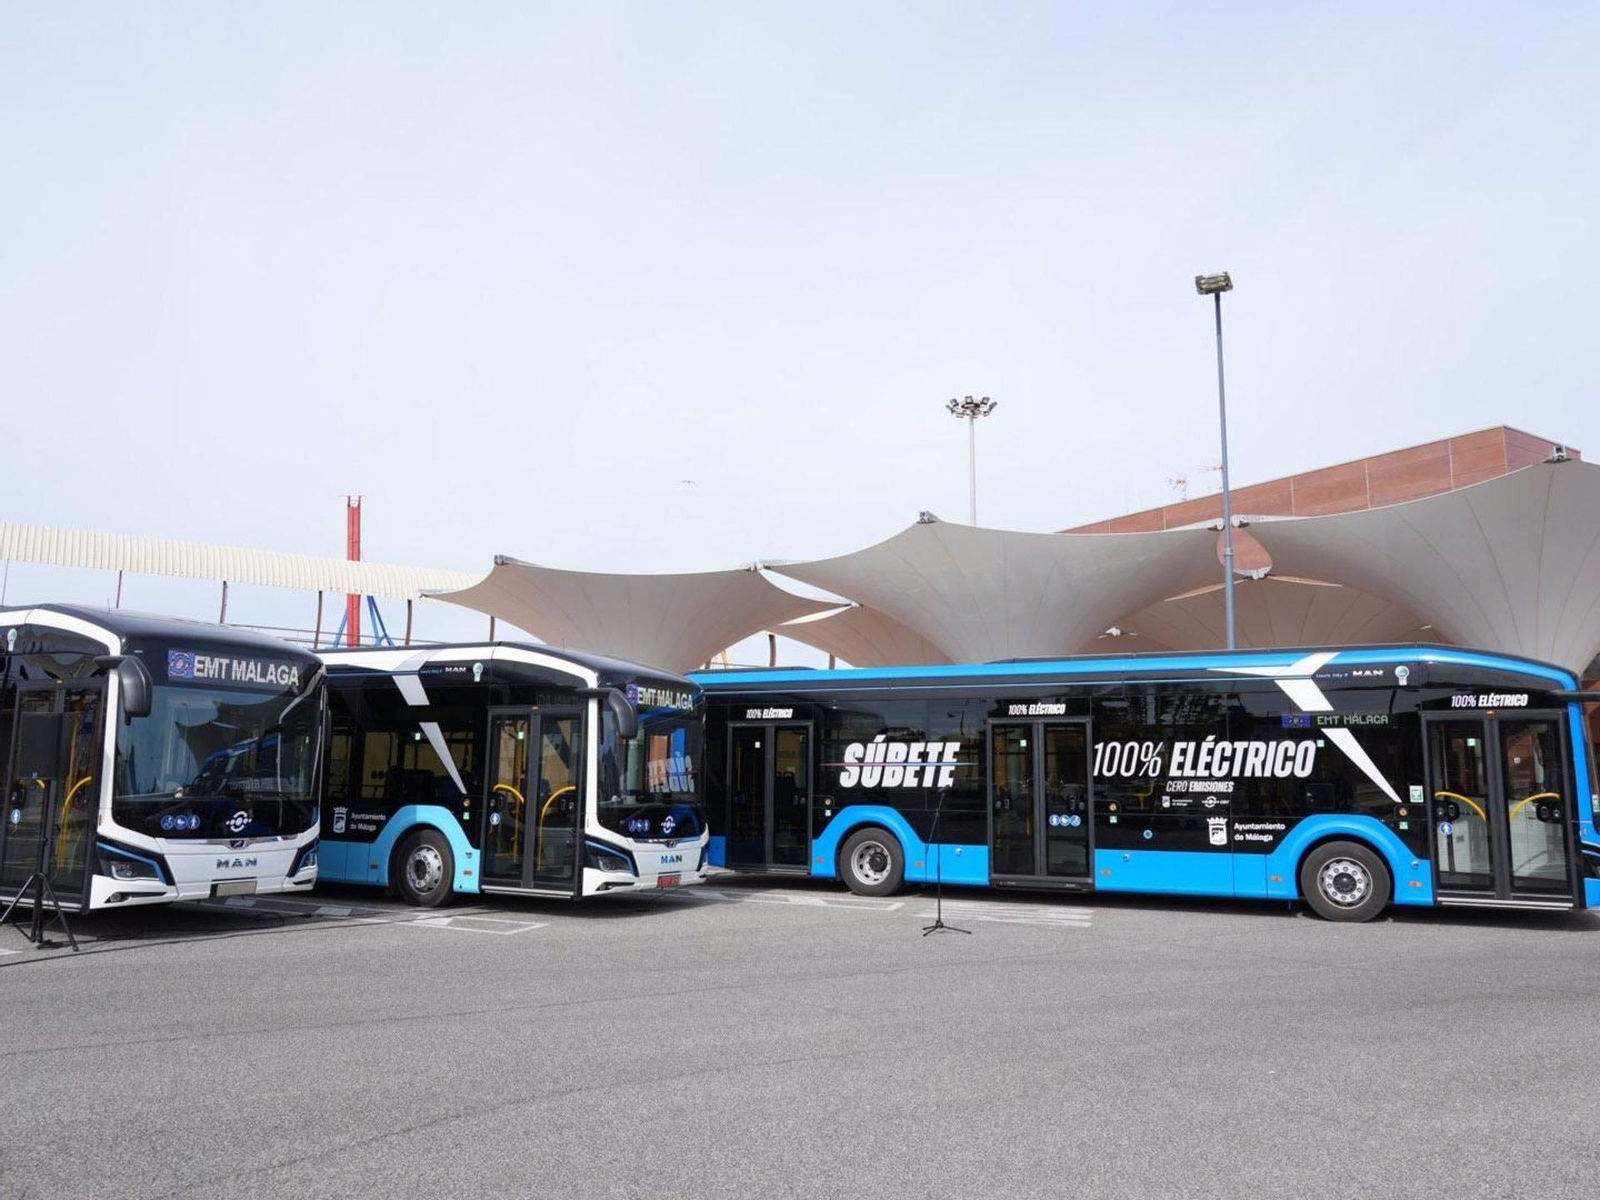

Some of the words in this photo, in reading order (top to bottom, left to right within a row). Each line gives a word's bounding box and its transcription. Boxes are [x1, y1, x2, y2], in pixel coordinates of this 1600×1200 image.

[194, 655, 229, 680] EMT
[1352, 669, 1384, 677] MAN
[637, 687, 656, 705] EMT
[1451, 694, 1477, 708] 100%
[1478, 692, 1528, 707] ELÉCTRICO
[746, 709, 762, 719] 100%
[762, 706, 793, 719] ELÉCTRICO
[1008, 704, 1028, 715] 100%
[1028, 702, 1066, 715] ELÉCTRICO
[1317, 715, 1340, 725] EMT
[1343, 713, 1389, 725] MÁLAGA
[840, 734, 960, 787] SÚBETE
[1092, 741, 1164, 778] 100%
[1168, 735, 1317, 779] ELÉCTRICO
[1166, 781, 1188, 793] CERO
[1188, 781, 1234, 793] EMISIONES
[1234, 822, 1286, 832] Ayuntamiento
[1234, 833, 1244, 841] de
[1245, 833, 1273, 842] Málaga
[216, 857, 258, 869] MAN
[660, 854, 683, 864] MAN
